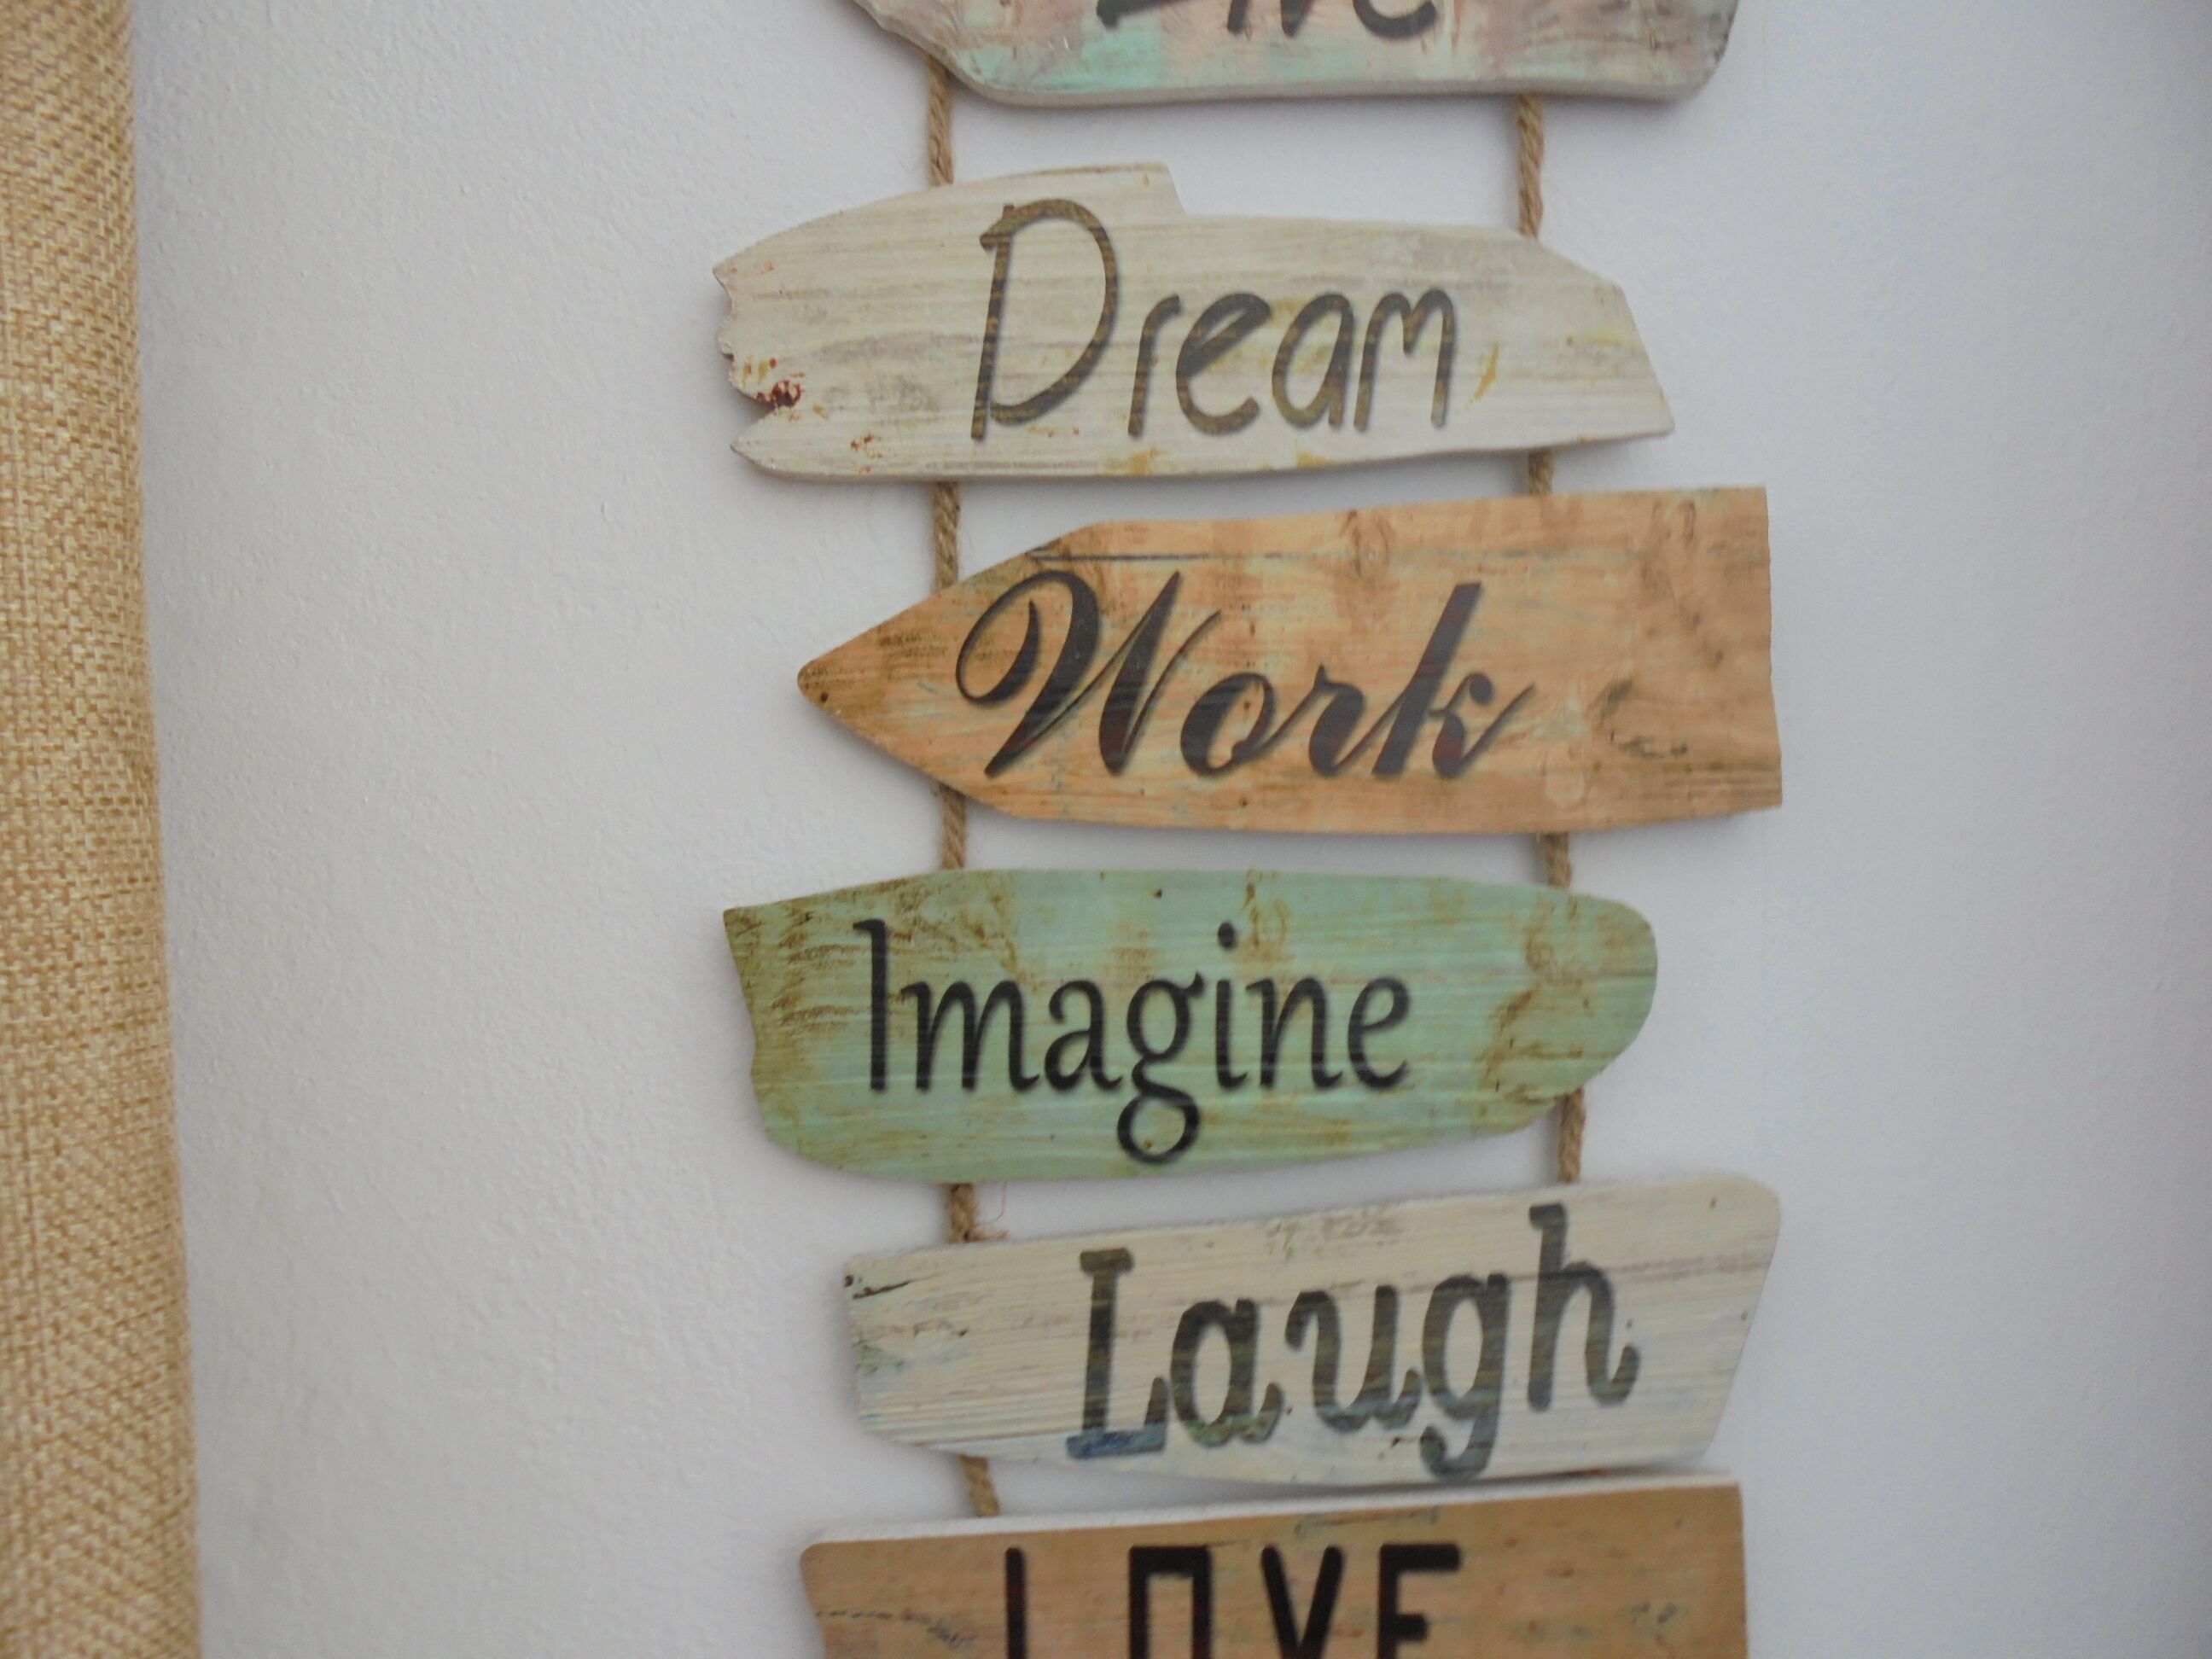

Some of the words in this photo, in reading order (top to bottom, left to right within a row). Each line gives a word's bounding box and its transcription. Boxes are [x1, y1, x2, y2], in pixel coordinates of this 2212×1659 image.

[970, 198, 1458, 439] Dream
[955, 569, 1536, 780] Work
[853, 917, 1413, 1165] Imagine
[1065, 1203, 1640, 1481] Laugh
